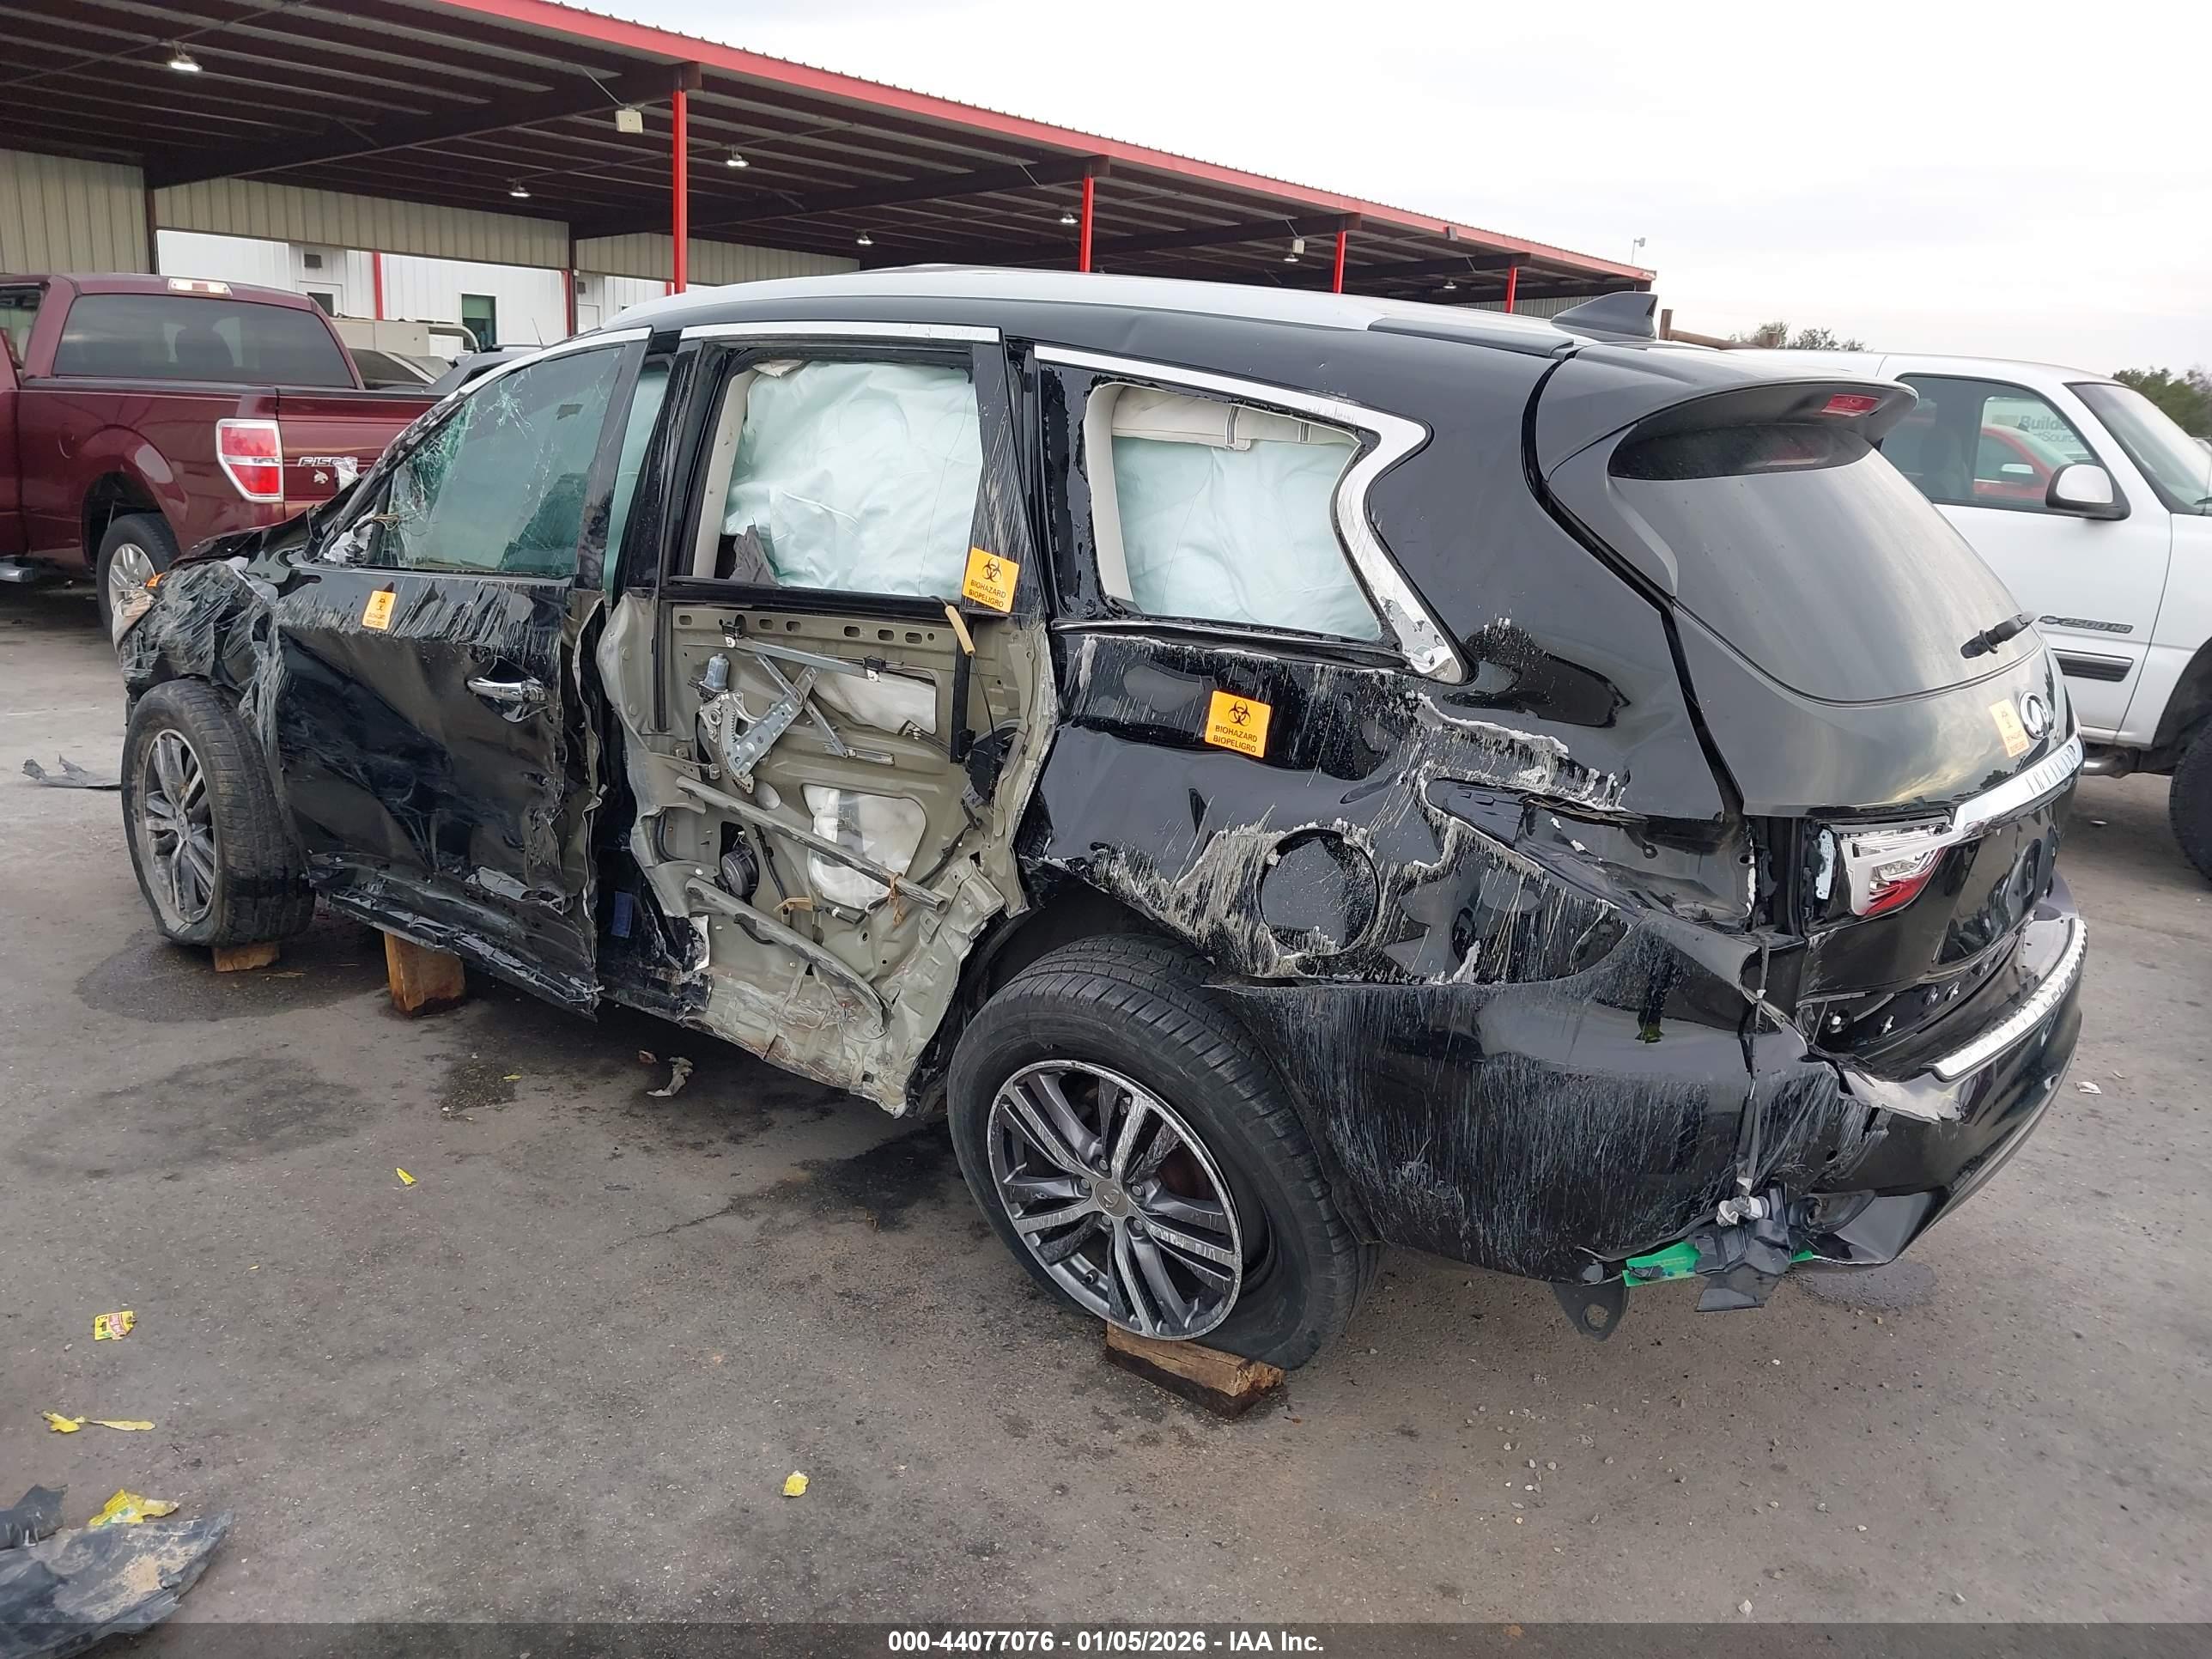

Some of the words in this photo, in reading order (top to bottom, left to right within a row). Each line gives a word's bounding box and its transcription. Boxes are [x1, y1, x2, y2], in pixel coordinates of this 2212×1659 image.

[969, 589, 1004, 608] BIOPELIGRO
[970, 580, 1006, 599] BIOHAZARD
[2060, 617, 2110, 630] 2500
[2110, 623, 2131, 633] HD
[1215, 725, 1258, 743] BIOHAZARD
[1212, 735, 1256, 753] BIOPELIGRO
